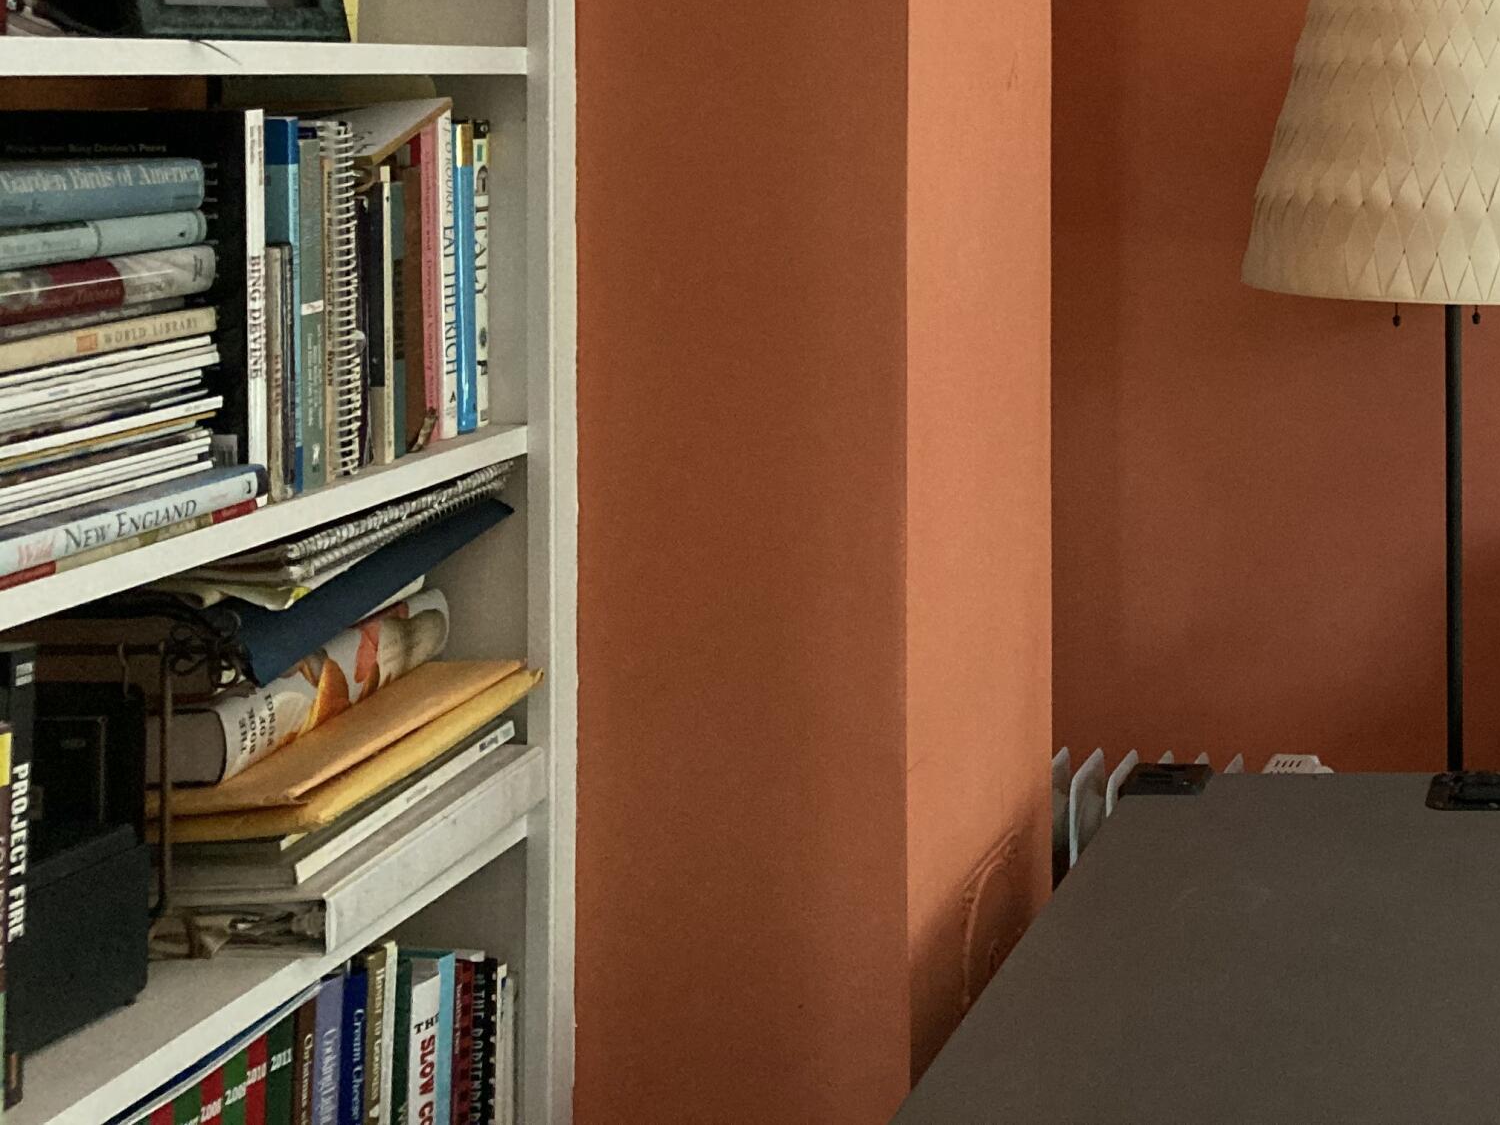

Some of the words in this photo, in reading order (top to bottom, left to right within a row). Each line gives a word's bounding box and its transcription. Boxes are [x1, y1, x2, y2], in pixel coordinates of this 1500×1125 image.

[70, 166, 115, 191] Birds
[116, 165, 133, 187] of
[139, 163, 201, 186] America
[443, 226, 455, 257] EAT
[475, 205, 488, 294] ITALY
[249, 254, 261, 301] BING
[444, 272, 456, 313] THE
[104, 328, 147, 344] WORLD
[153, 317, 199, 336] LIBRARY
[249, 307, 262, 379] DEVINE
[445, 320, 457, 375] RICH
[64, 523, 111, 554] NEW
[116, 499, 197, 538] ENGLAND
[248, 707, 256, 754] BOOK
[9, 762, 31, 876] PROJECT
[7, 884, 27, 943] FIRE
[270, 1048, 292, 1072] 2011
[353, 1008, 365, 1062] Cream
[246, 1062, 267, 1086] 2010
[419, 1035, 436, 1095] SLOW
